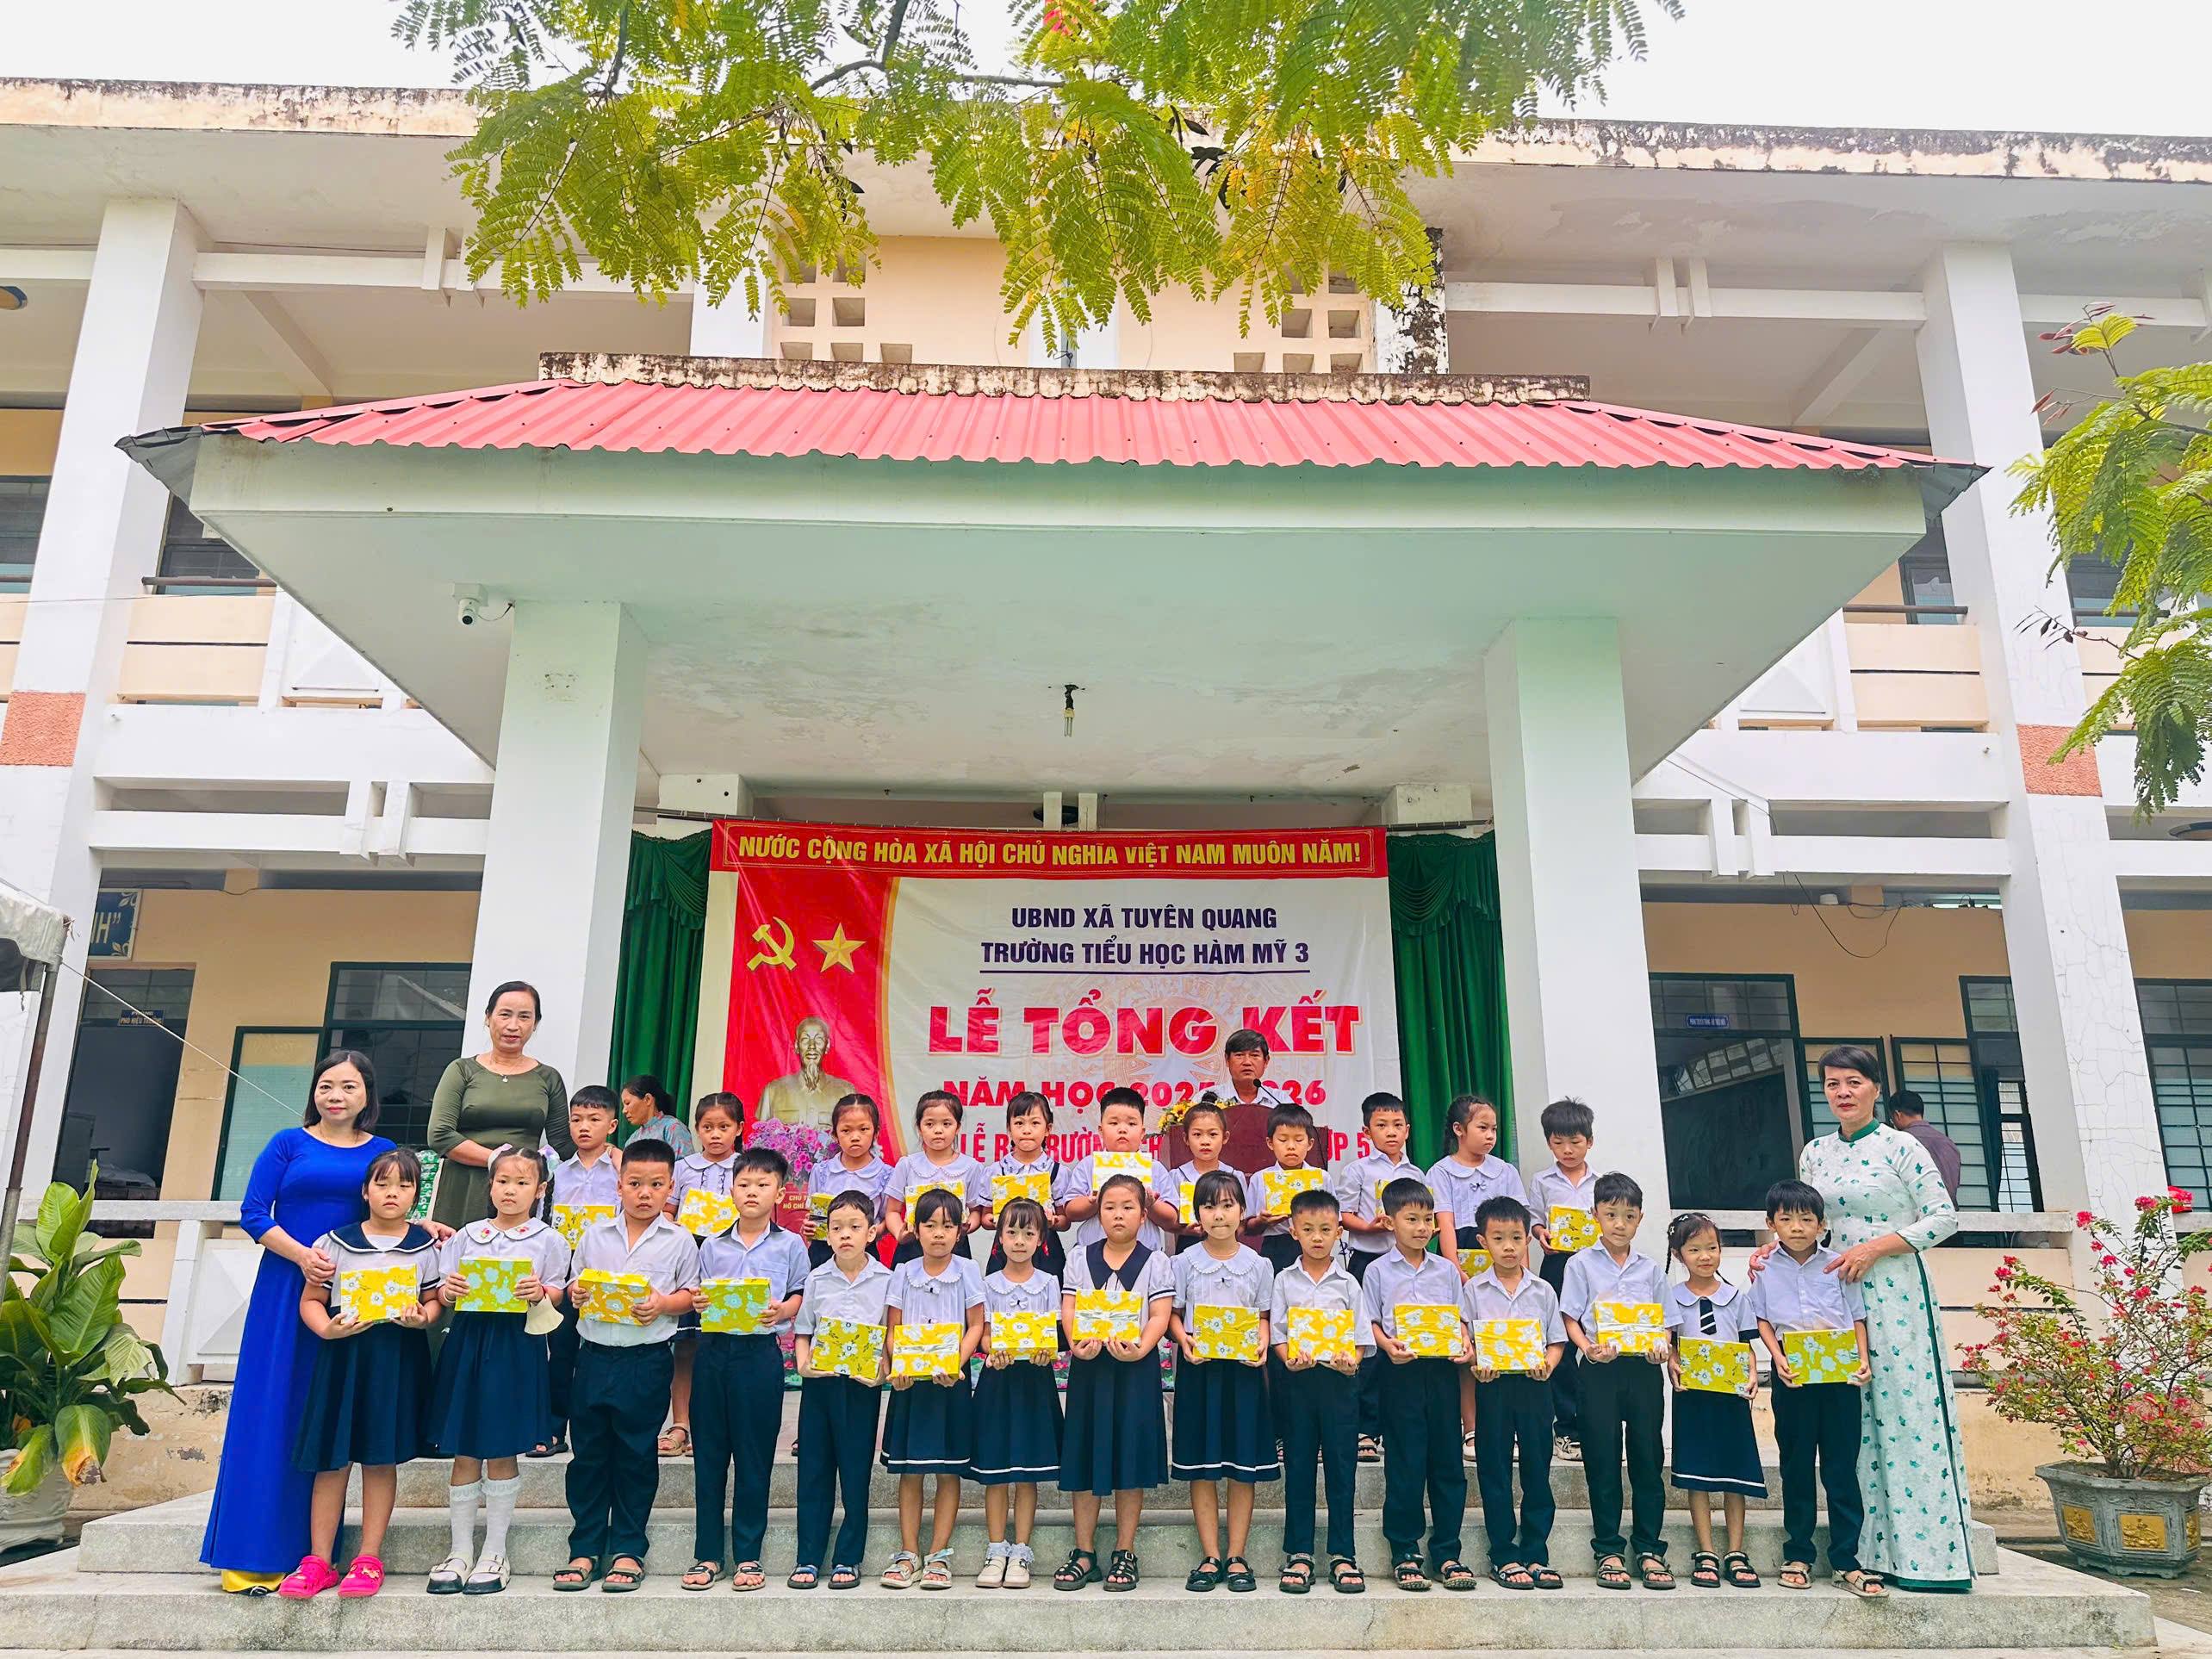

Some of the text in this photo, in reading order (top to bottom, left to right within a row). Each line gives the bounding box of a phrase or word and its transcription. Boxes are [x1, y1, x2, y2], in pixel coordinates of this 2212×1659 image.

[739, 833, 1360, 868] NƯỚC CỘNG HÒA XÃ HỘI CHỦ NGHĨA VIỆT NAM MUÔN NĂM!
[1011, 904, 1277, 931] UBND XÃ TUYÊN QUANG
[981, 935, 1309, 969] TRƯỜNG TIỂU HỌC HÀM MỸ 3
[929, 987, 1360, 1056] LỄ TỔNG KẾT
[943, 1076, 1025, 1107] NĂM
[1130, 1081, 1215, 1108] 202
[1357, 1132, 1370, 1159] 5
